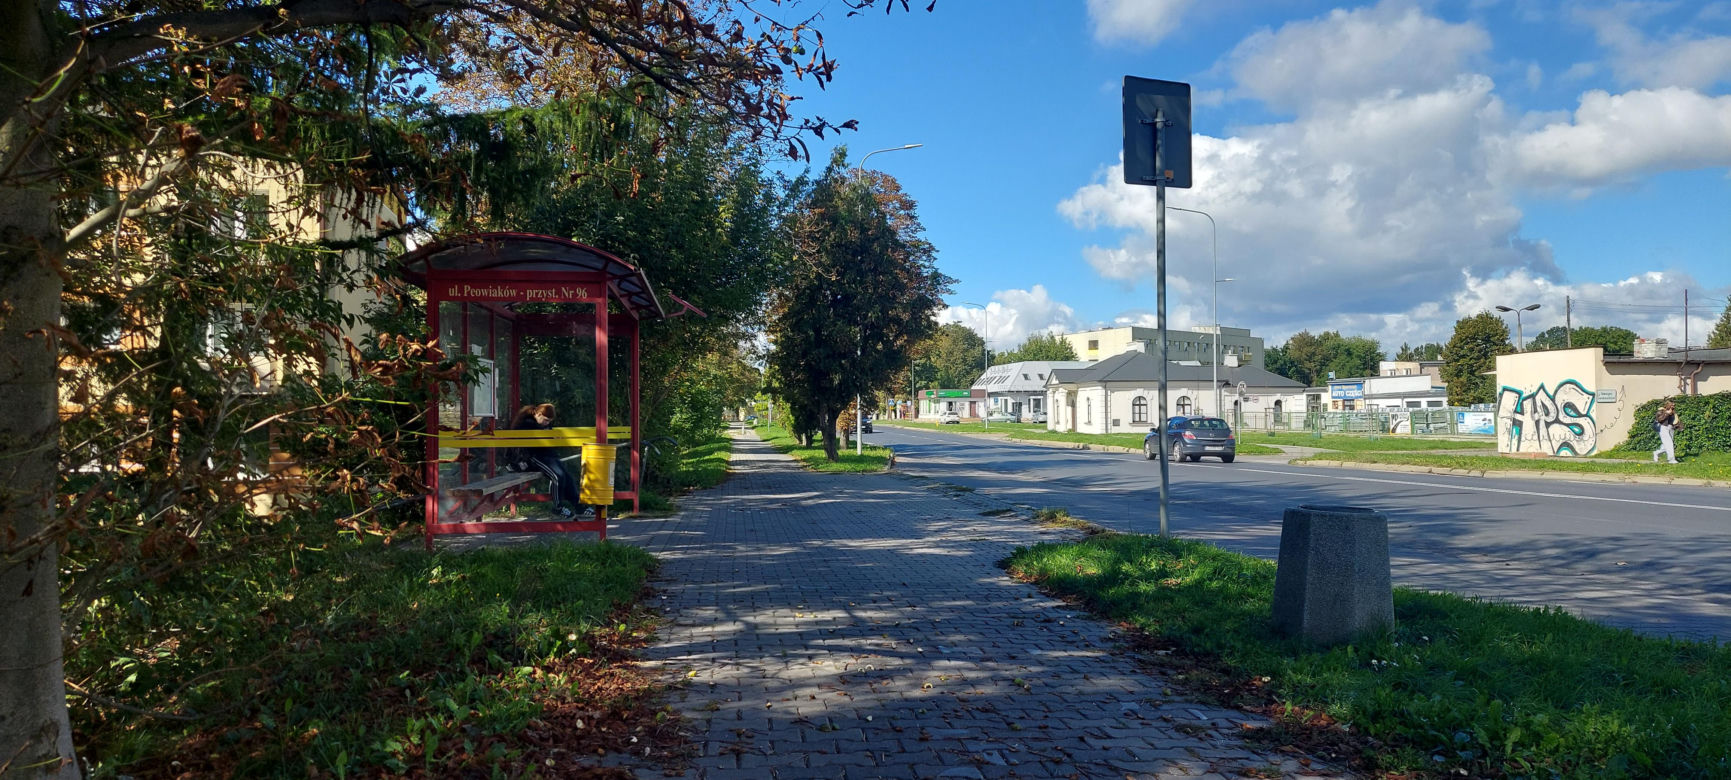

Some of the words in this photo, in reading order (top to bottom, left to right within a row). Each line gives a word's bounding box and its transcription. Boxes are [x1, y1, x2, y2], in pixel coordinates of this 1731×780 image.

[448, 284, 461, 297] ul.
[463, 284, 518, 298] Peowiaków
[526, 287, 559, 301] przyst.
[561, 286, 575, 299] Nr
[576, 287, 588, 299] 96
